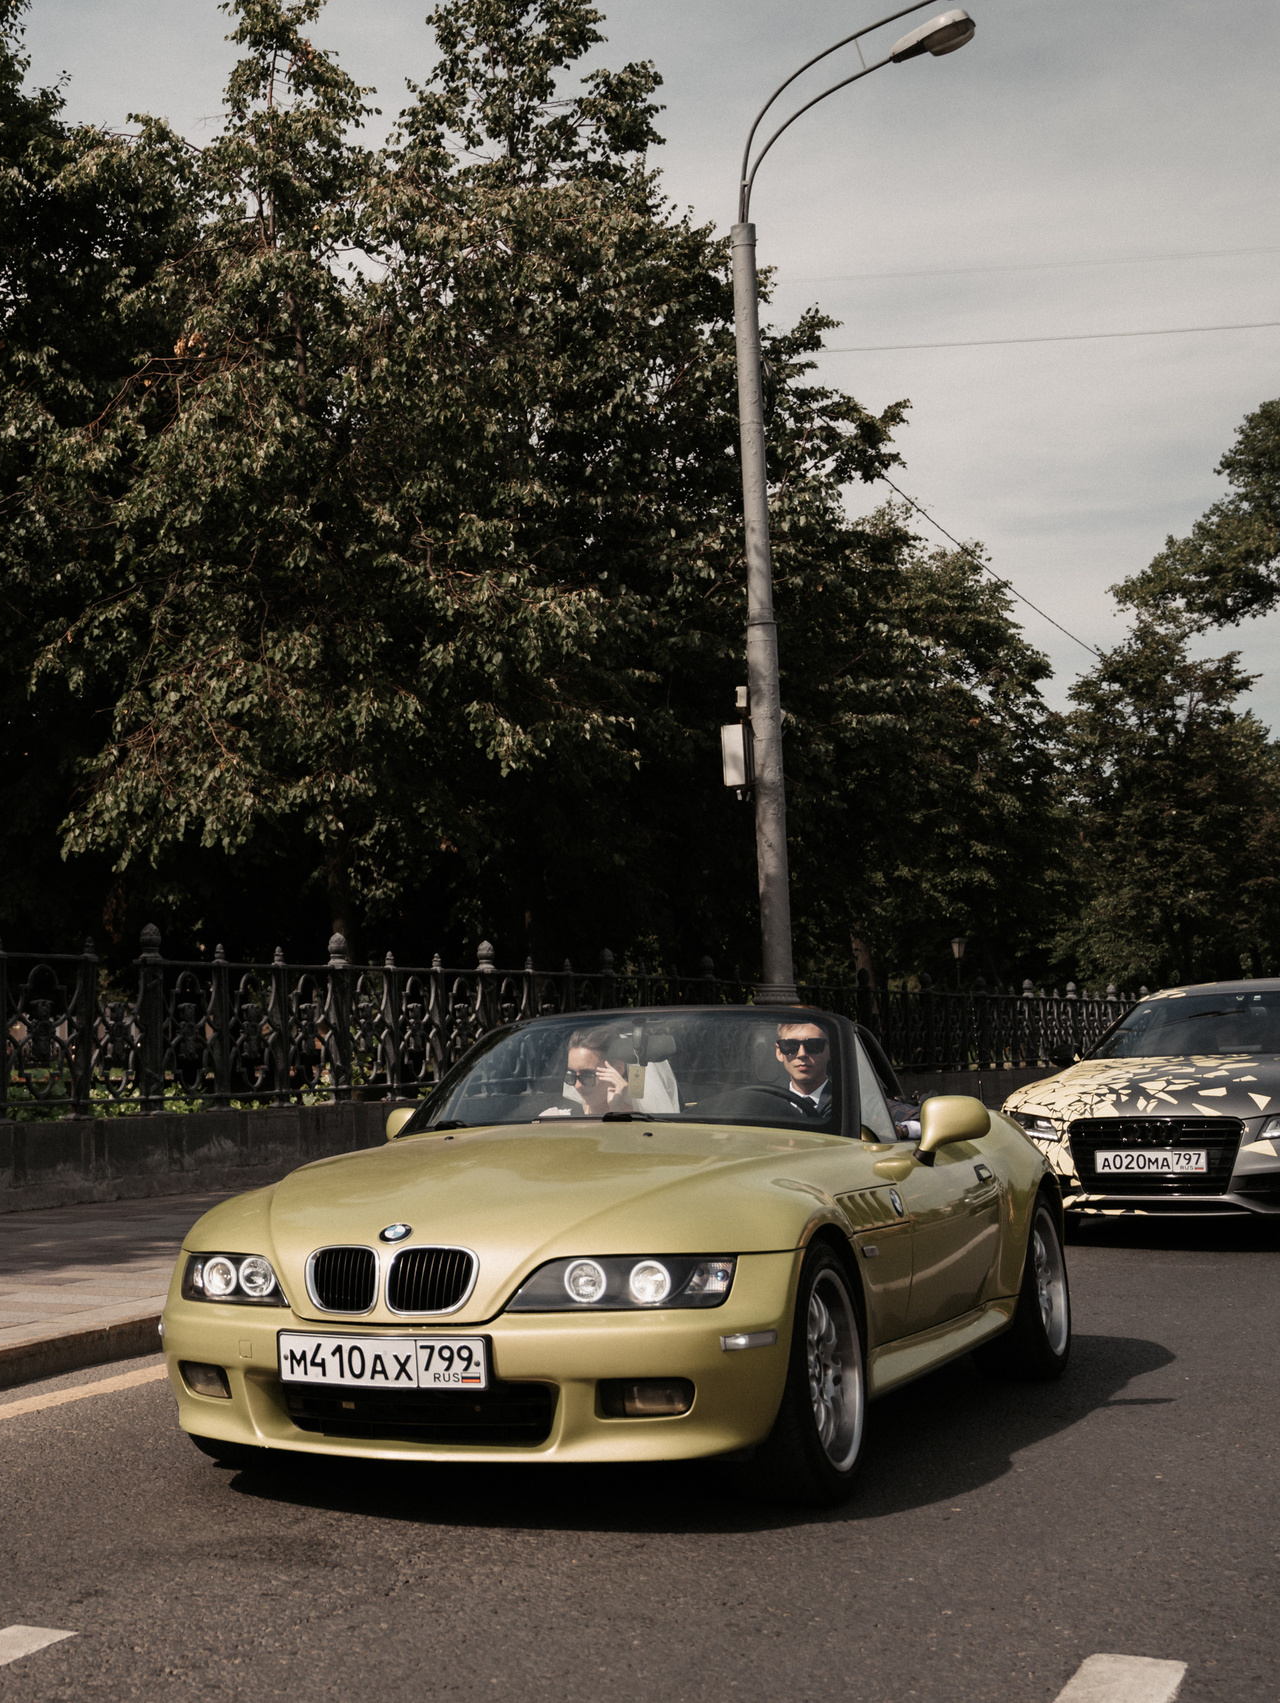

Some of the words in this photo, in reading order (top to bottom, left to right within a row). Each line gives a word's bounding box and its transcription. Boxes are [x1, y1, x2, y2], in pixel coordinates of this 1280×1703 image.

[1102, 1154, 1170, 1170] А020МА
[1174, 1153, 1201, 1165] 797
[289, 1343, 413, 1381] М410АХ
[419, 1344, 473, 1372] 799
[433, 1372, 460, 1383] RUS
